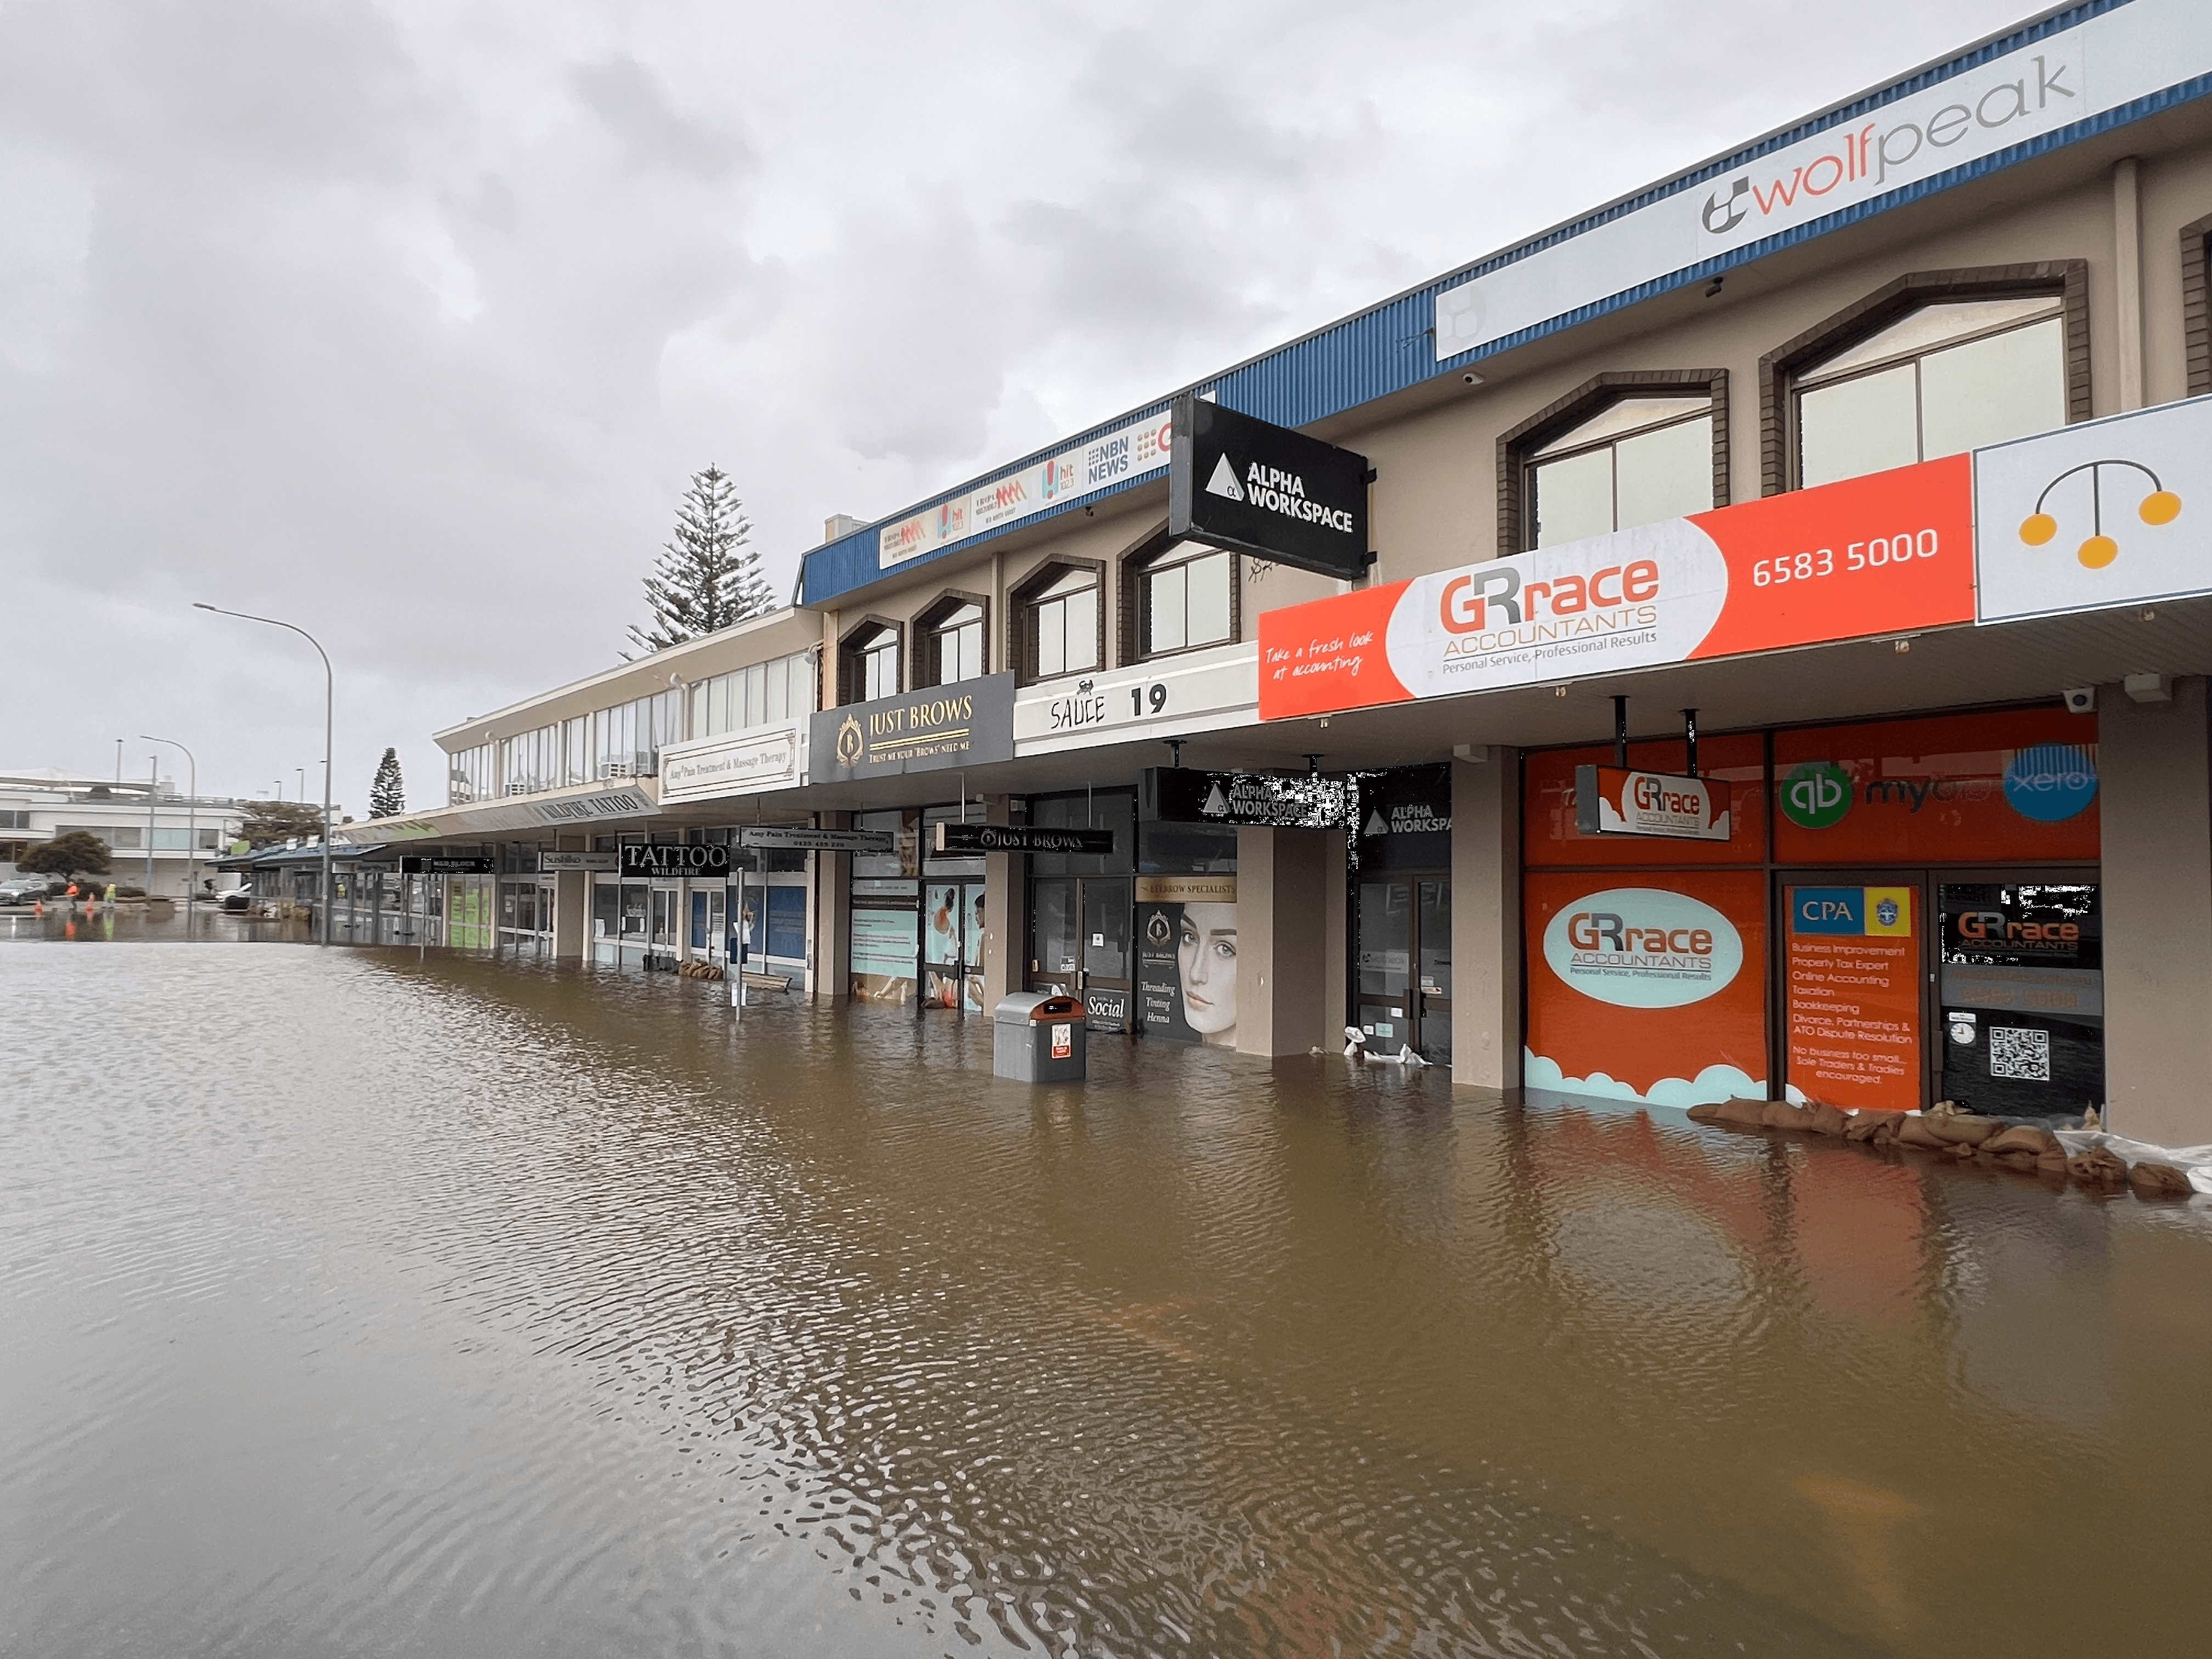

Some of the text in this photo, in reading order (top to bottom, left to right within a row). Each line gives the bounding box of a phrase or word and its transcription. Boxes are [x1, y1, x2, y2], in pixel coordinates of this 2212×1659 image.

[1752, 55, 2076, 215] wolfpeak
[1099, 436, 1129, 465] NBN
[1088, 454, 1128, 485] NEWS
[1247, 461, 1306, 498] ALPHA
[1246, 482, 1353, 533] WORKSPACE
[1753, 528, 1938, 588] 6583 5000
[1443, 605, 1657, 657] ACCOUNTANTS
[1266, 630, 1374, 663] Take a fresh look
[1442, 631, 1657, 675] Personal Service, Professional Results
[1273, 655, 1364, 681] at accounting
[1051, 684, 1166, 730] SAUCE 19
[869, 694, 973, 739] JUST BROWS
[941, 742, 958, 754] NEED
[960, 741, 970, 751] ME
[697, 761, 725, 775] Treatment
[726, 759, 732, 770] &
[733, 757, 758, 769] Massage
[759, 752, 787, 765] Therapy
[2013, 770, 2089, 793] xero
[1232, 784, 1273, 801] ALPHA
[540, 794, 639, 819] WILDFIRE TATTOO
[1232, 800, 1308, 818] WORKSPACE
[1390, 805, 1434, 820] ALPHA
[1390, 817, 1452, 833] WORKSPA
[997, 833, 1082, 849] JUST BROWS
[624, 845, 727, 867] TATTOO
[651, 867, 702, 876] WILDFIRE
[1802, 901, 1854, 922] CPA
[1792, 943, 1905, 956] Business Improvement
[1961, 939, 2079, 951] ACCOUNTANTS
[1571, 952, 1712, 969] ACCOUNTANTS
[1792, 957, 1889, 972] Property Tax Expert
[1570, 967, 1601, 975] Personal
[1632, 969, 1681, 980] Professional
[1681, 972, 1712, 981] Results
[1792, 970, 1890, 988] Online Accounting
[1141, 981, 1176, 997] Threading
[1793, 985, 1835, 996] Taxation
[1087, 996, 1125, 1018] Social
[1793, 998, 1860, 1015] Bookkeeping
[1147, 1012, 1170, 1024] Henna
[1836, 1017, 1899, 1032] Partnerships
[1901, 1022, 1911, 1032] &
[1793, 1025, 1912, 1044] ATO Dispute Resolution
[1792, 1046, 1807, 1054] No
[1809, 1047, 1850, 1059] business
[1852, 1051, 1870, 1061] too
[1796, 1056, 1816, 1066] Sole
[1819, 1058, 1855, 1070] Traders
[1857, 1062, 1865, 1071] &
